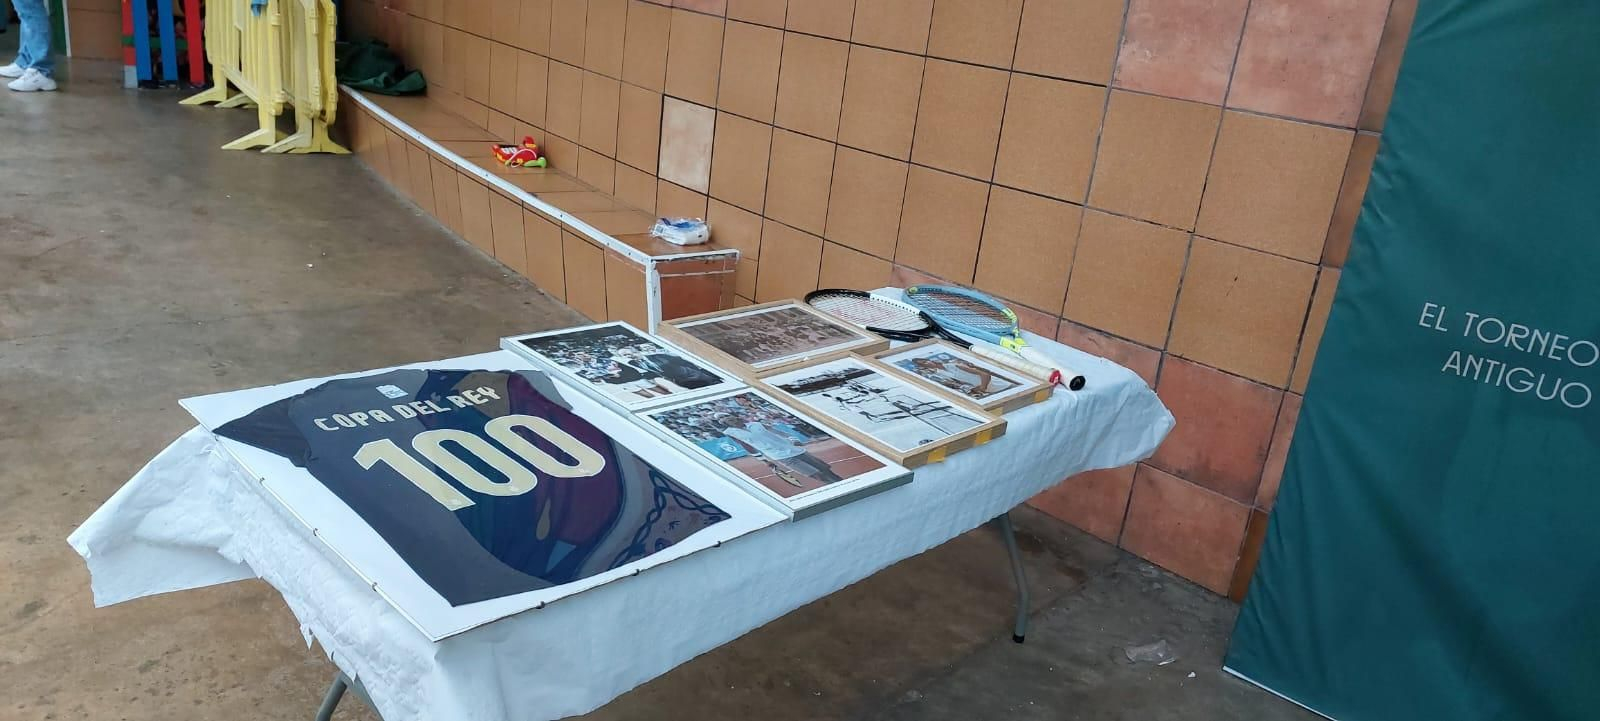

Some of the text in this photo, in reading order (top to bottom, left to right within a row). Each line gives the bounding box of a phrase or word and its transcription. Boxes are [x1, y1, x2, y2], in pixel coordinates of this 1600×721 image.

[1419, 302, 1600, 367] EL TORNEO
[313, 386, 502, 432] COPA DEL REY
[1441, 350, 1592, 409] ANTIGUO
[352, 413, 606, 512] 100
